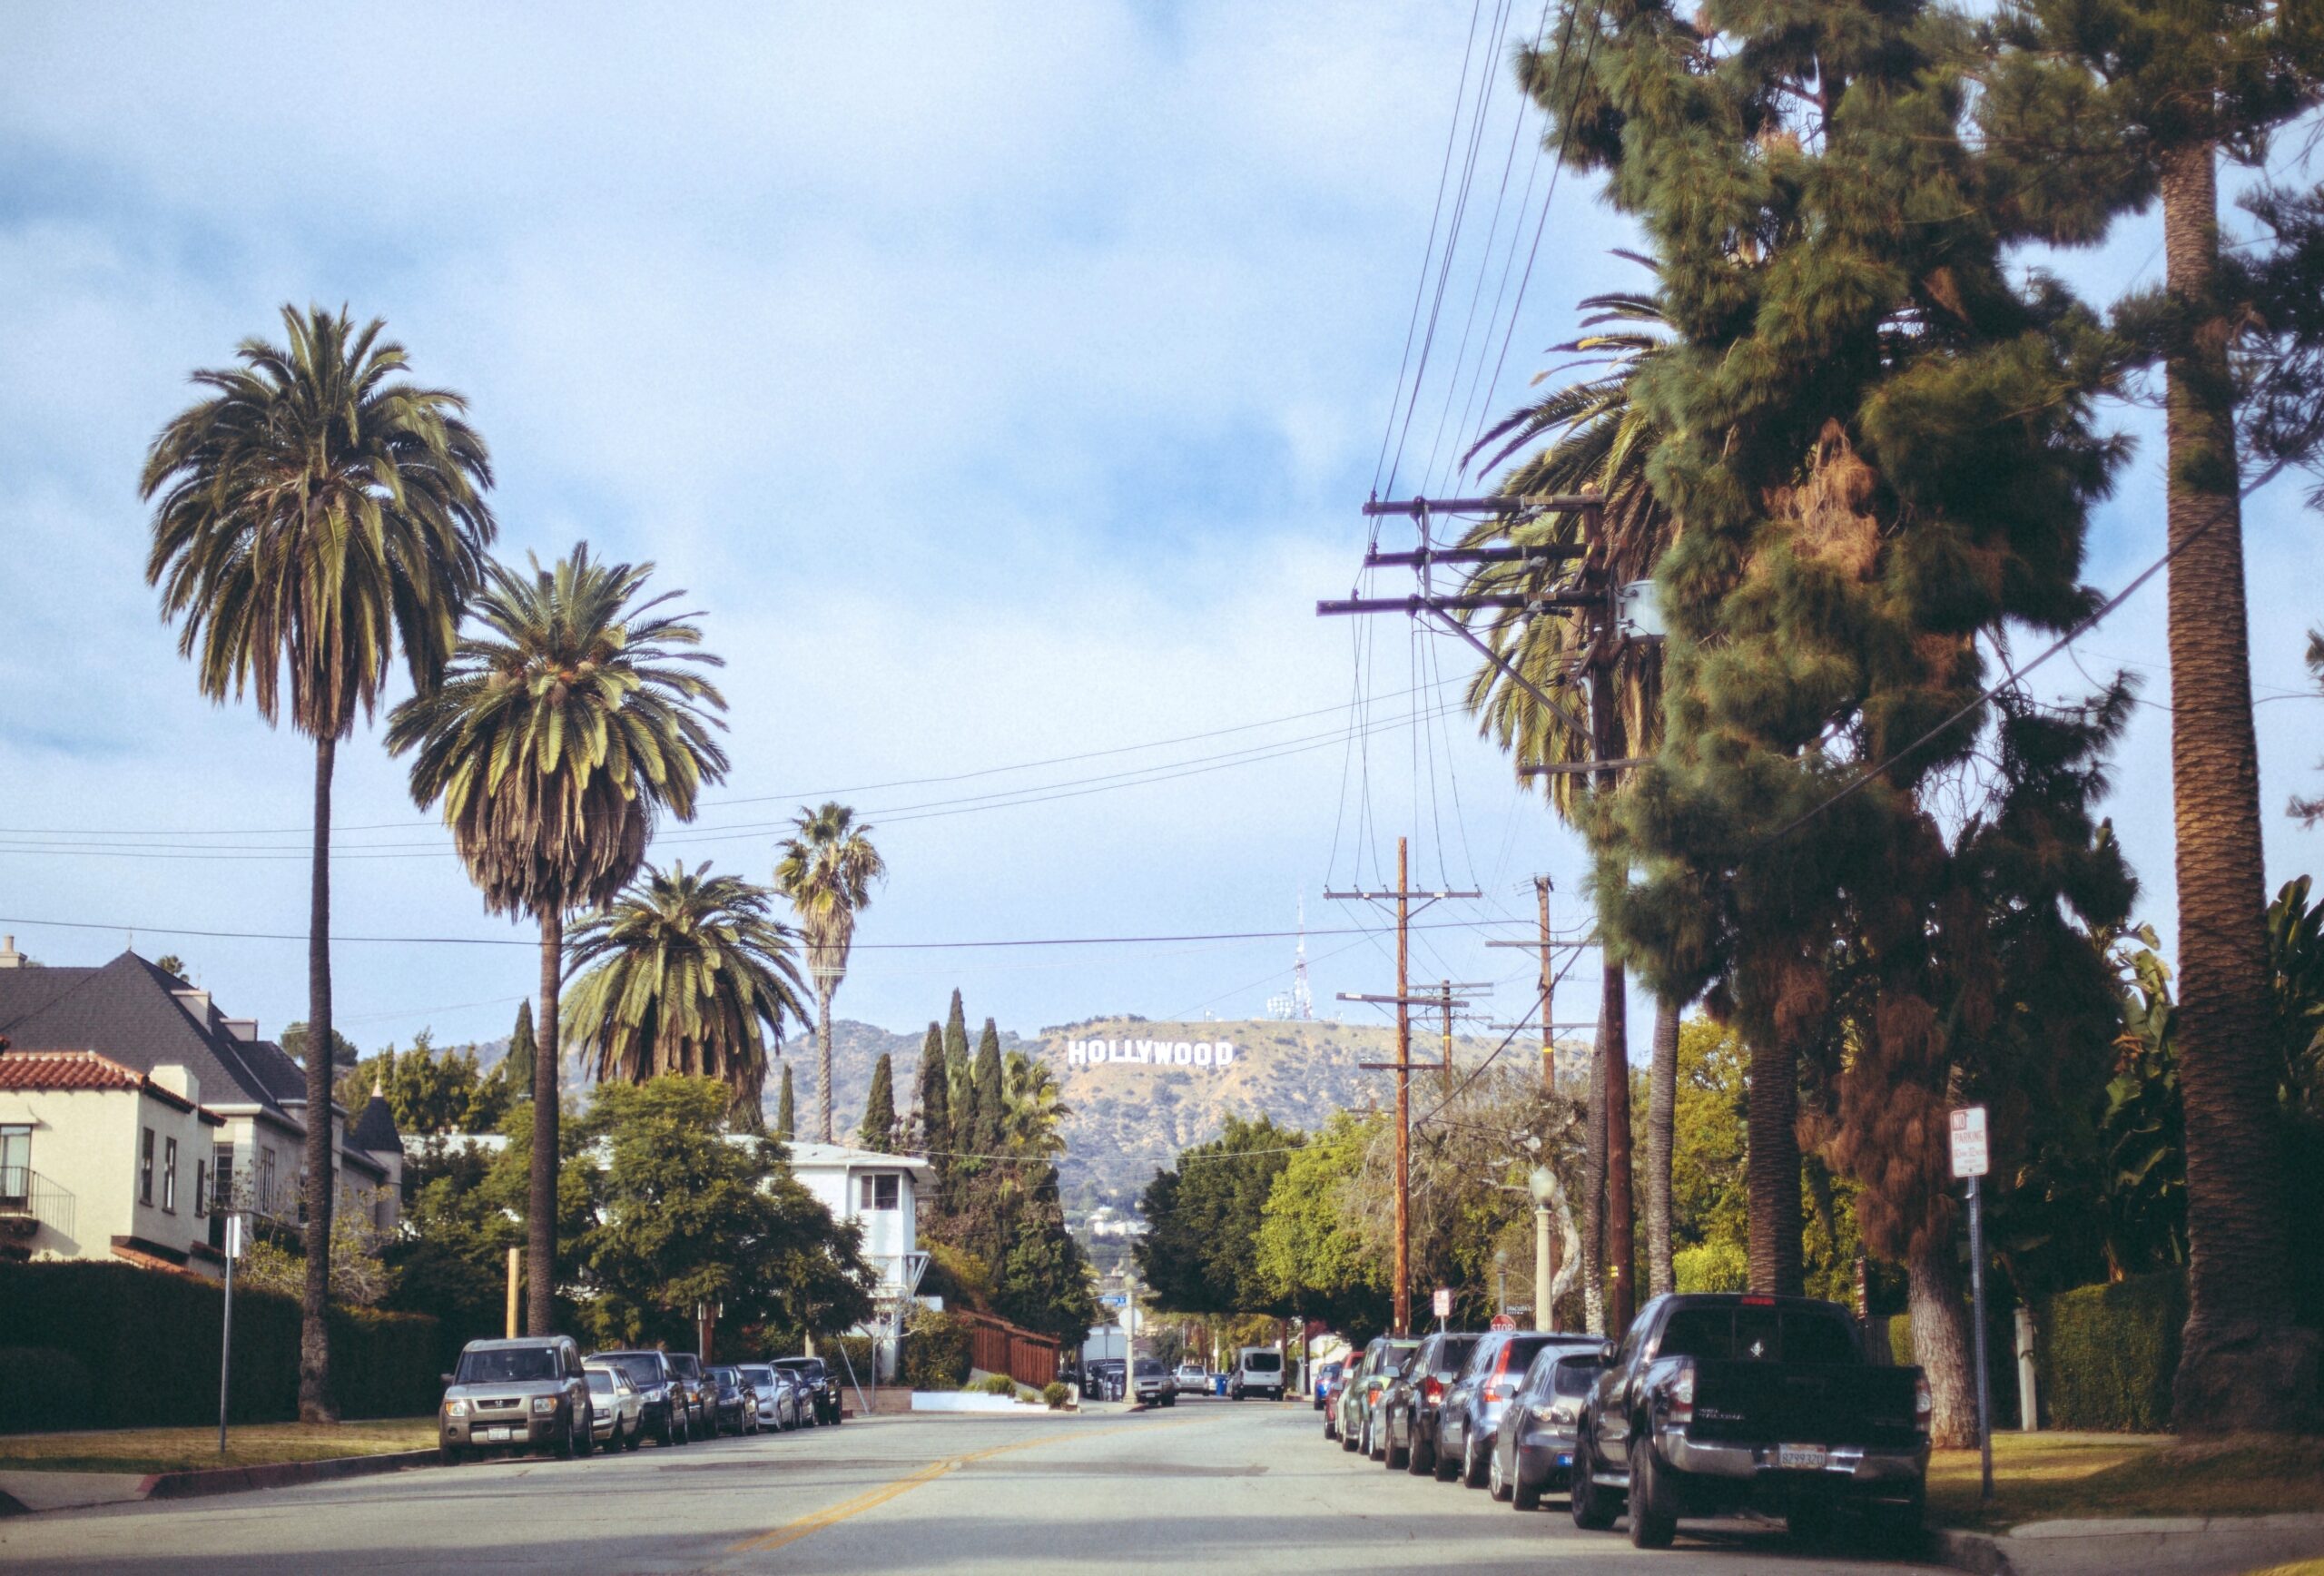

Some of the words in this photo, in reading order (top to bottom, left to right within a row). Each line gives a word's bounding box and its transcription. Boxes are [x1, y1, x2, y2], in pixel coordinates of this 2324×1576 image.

[1068, 1039, 1233, 1066] HOLLYWOOD
[1952, 1114, 1965, 1128] NO
[1954, 1130, 1984, 1144] PARKING
[1492, 1323, 1514, 1331] STOP
